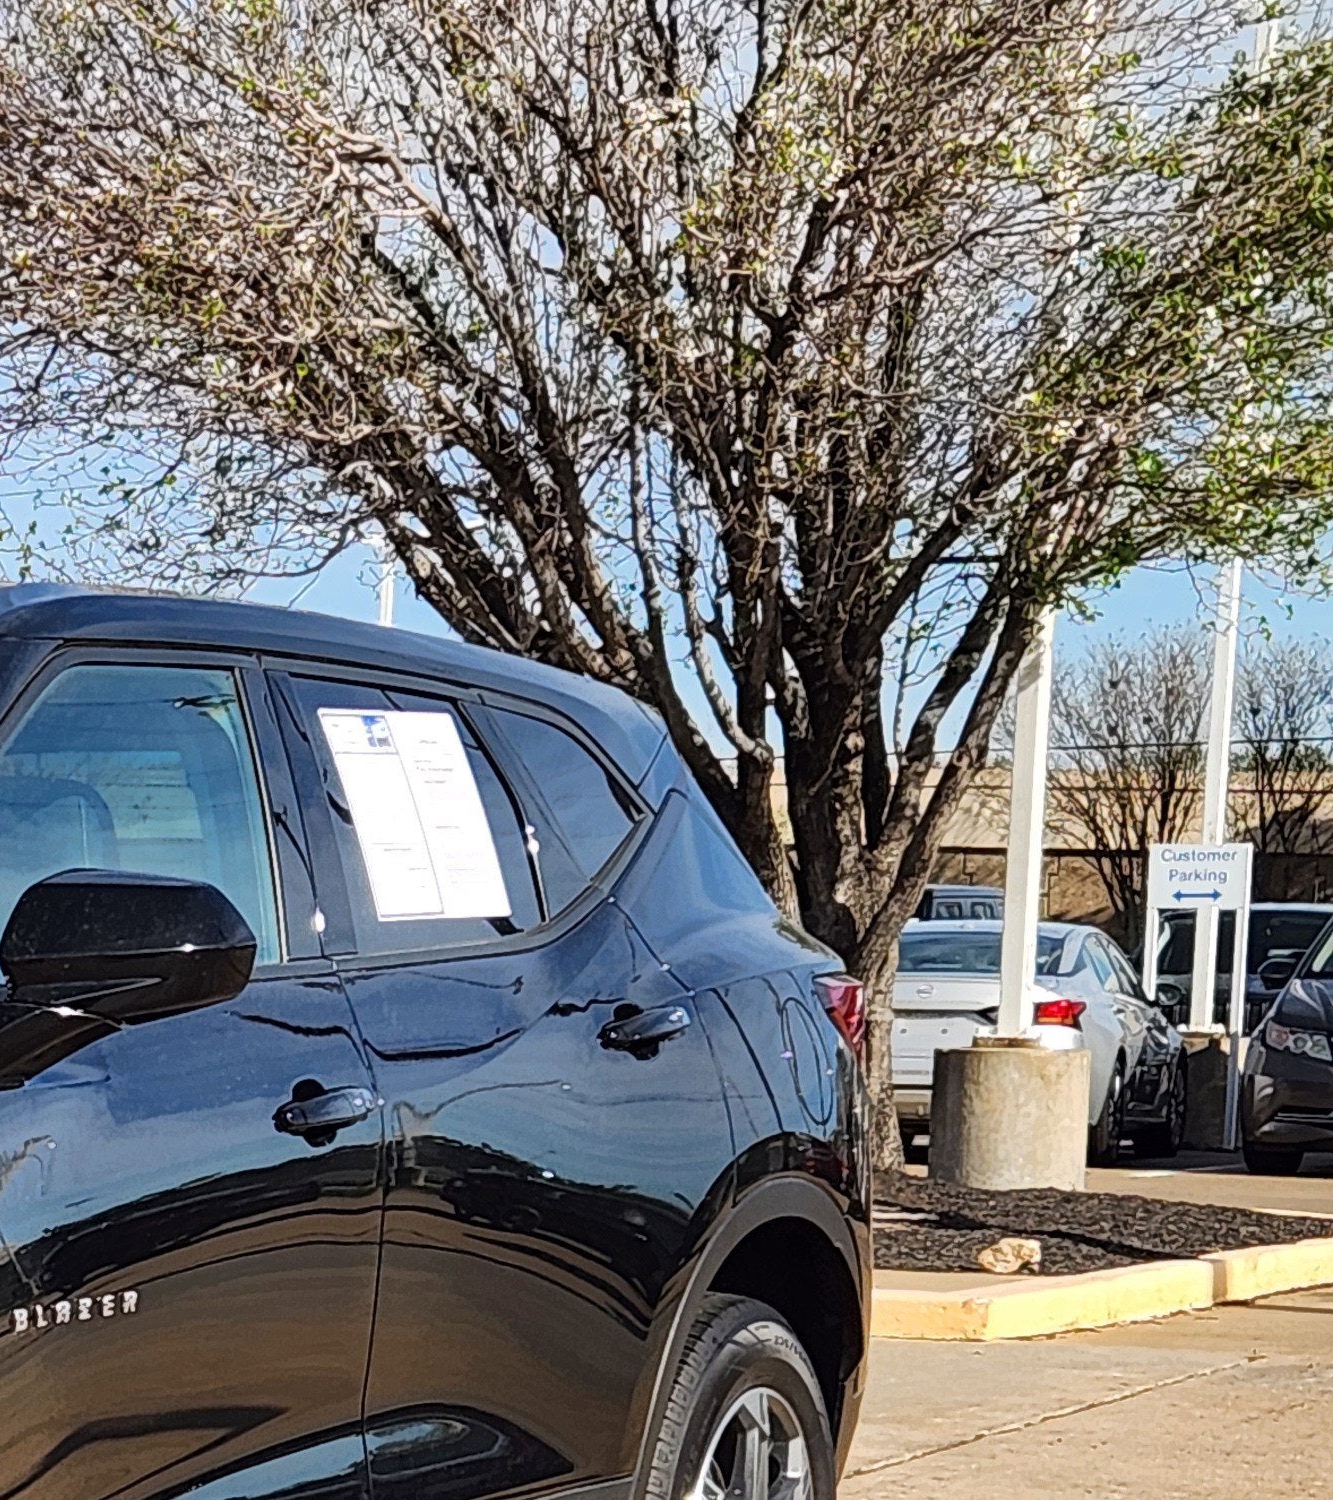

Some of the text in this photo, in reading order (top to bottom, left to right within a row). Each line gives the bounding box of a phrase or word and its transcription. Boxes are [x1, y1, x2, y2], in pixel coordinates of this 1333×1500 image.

[1160, 848, 1238, 863] Customer
[1168, 868, 1228, 885] Parking
[12, 1289, 139, 1333] BLAZER
